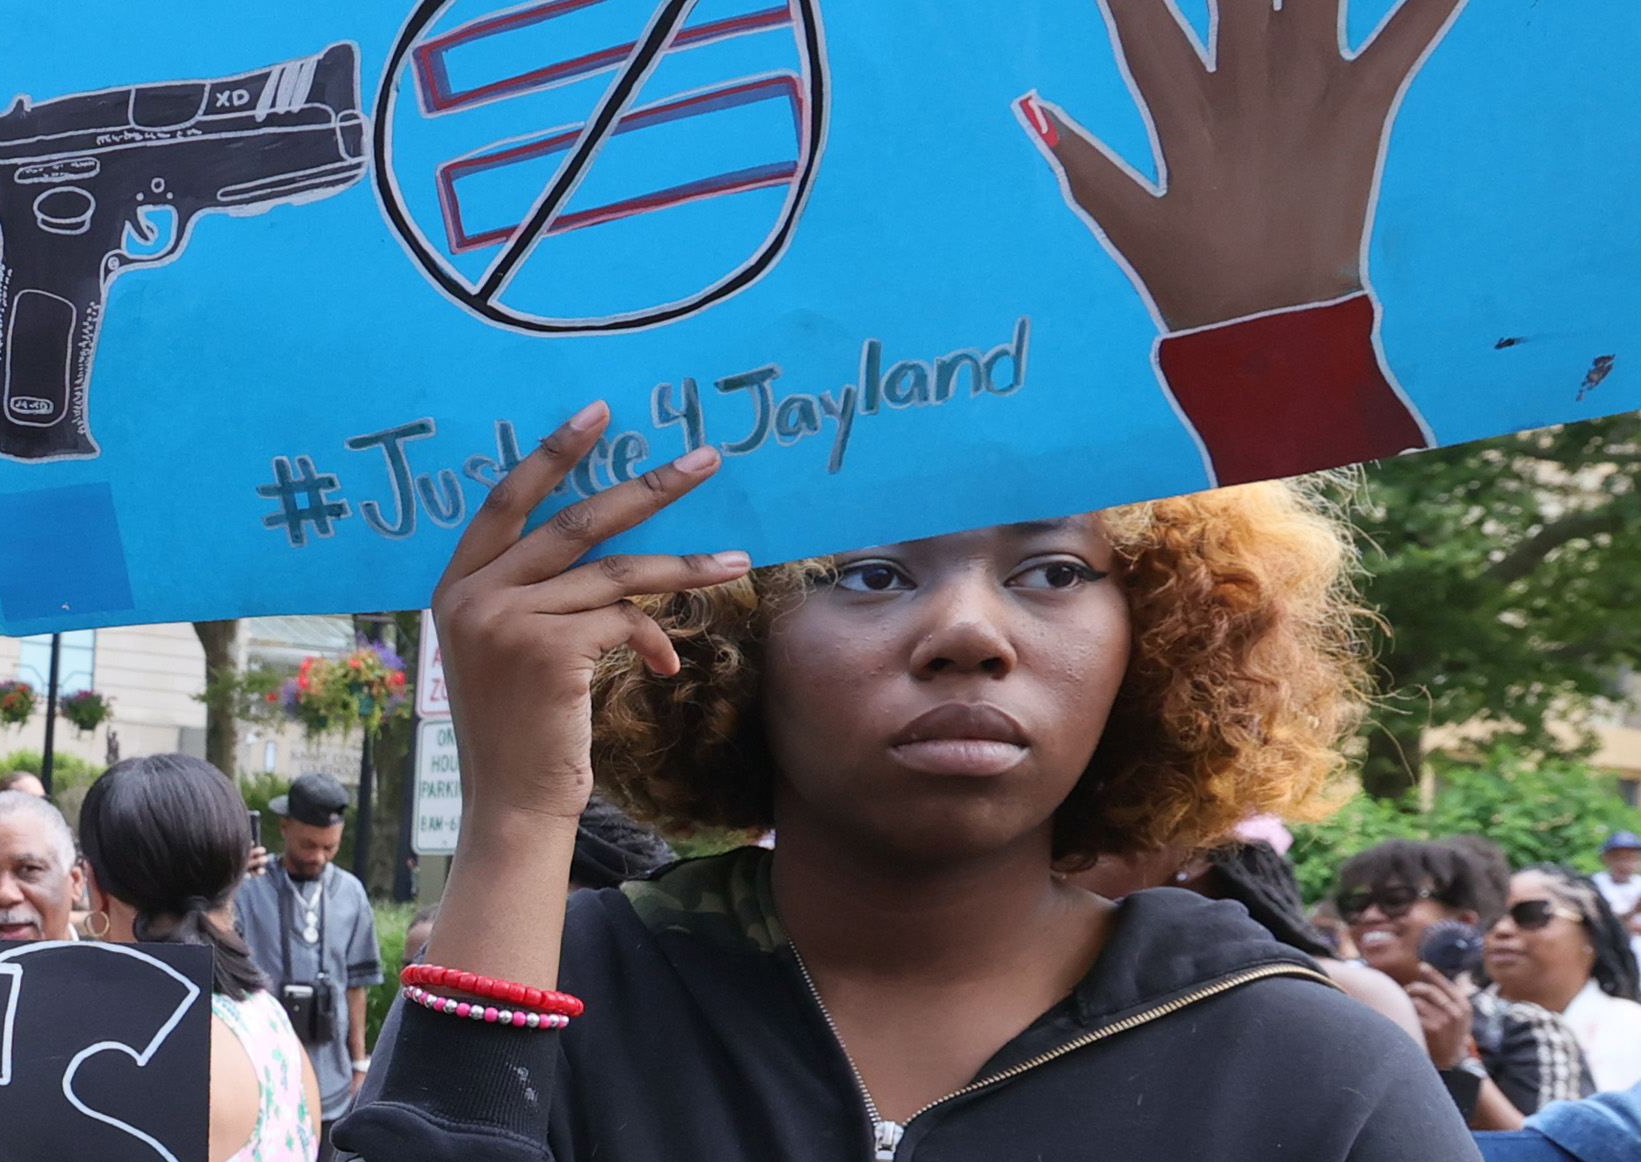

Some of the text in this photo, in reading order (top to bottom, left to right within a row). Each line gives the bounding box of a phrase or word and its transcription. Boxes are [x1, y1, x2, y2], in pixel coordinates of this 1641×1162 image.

[215, 88, 251, 108] XD
[437, 728, 457, 747] ON
[431, 755, 461, 773] HOU
[421, 780, 461, 799] PARKI
[421, 815, 461, 833] 8AM-6
